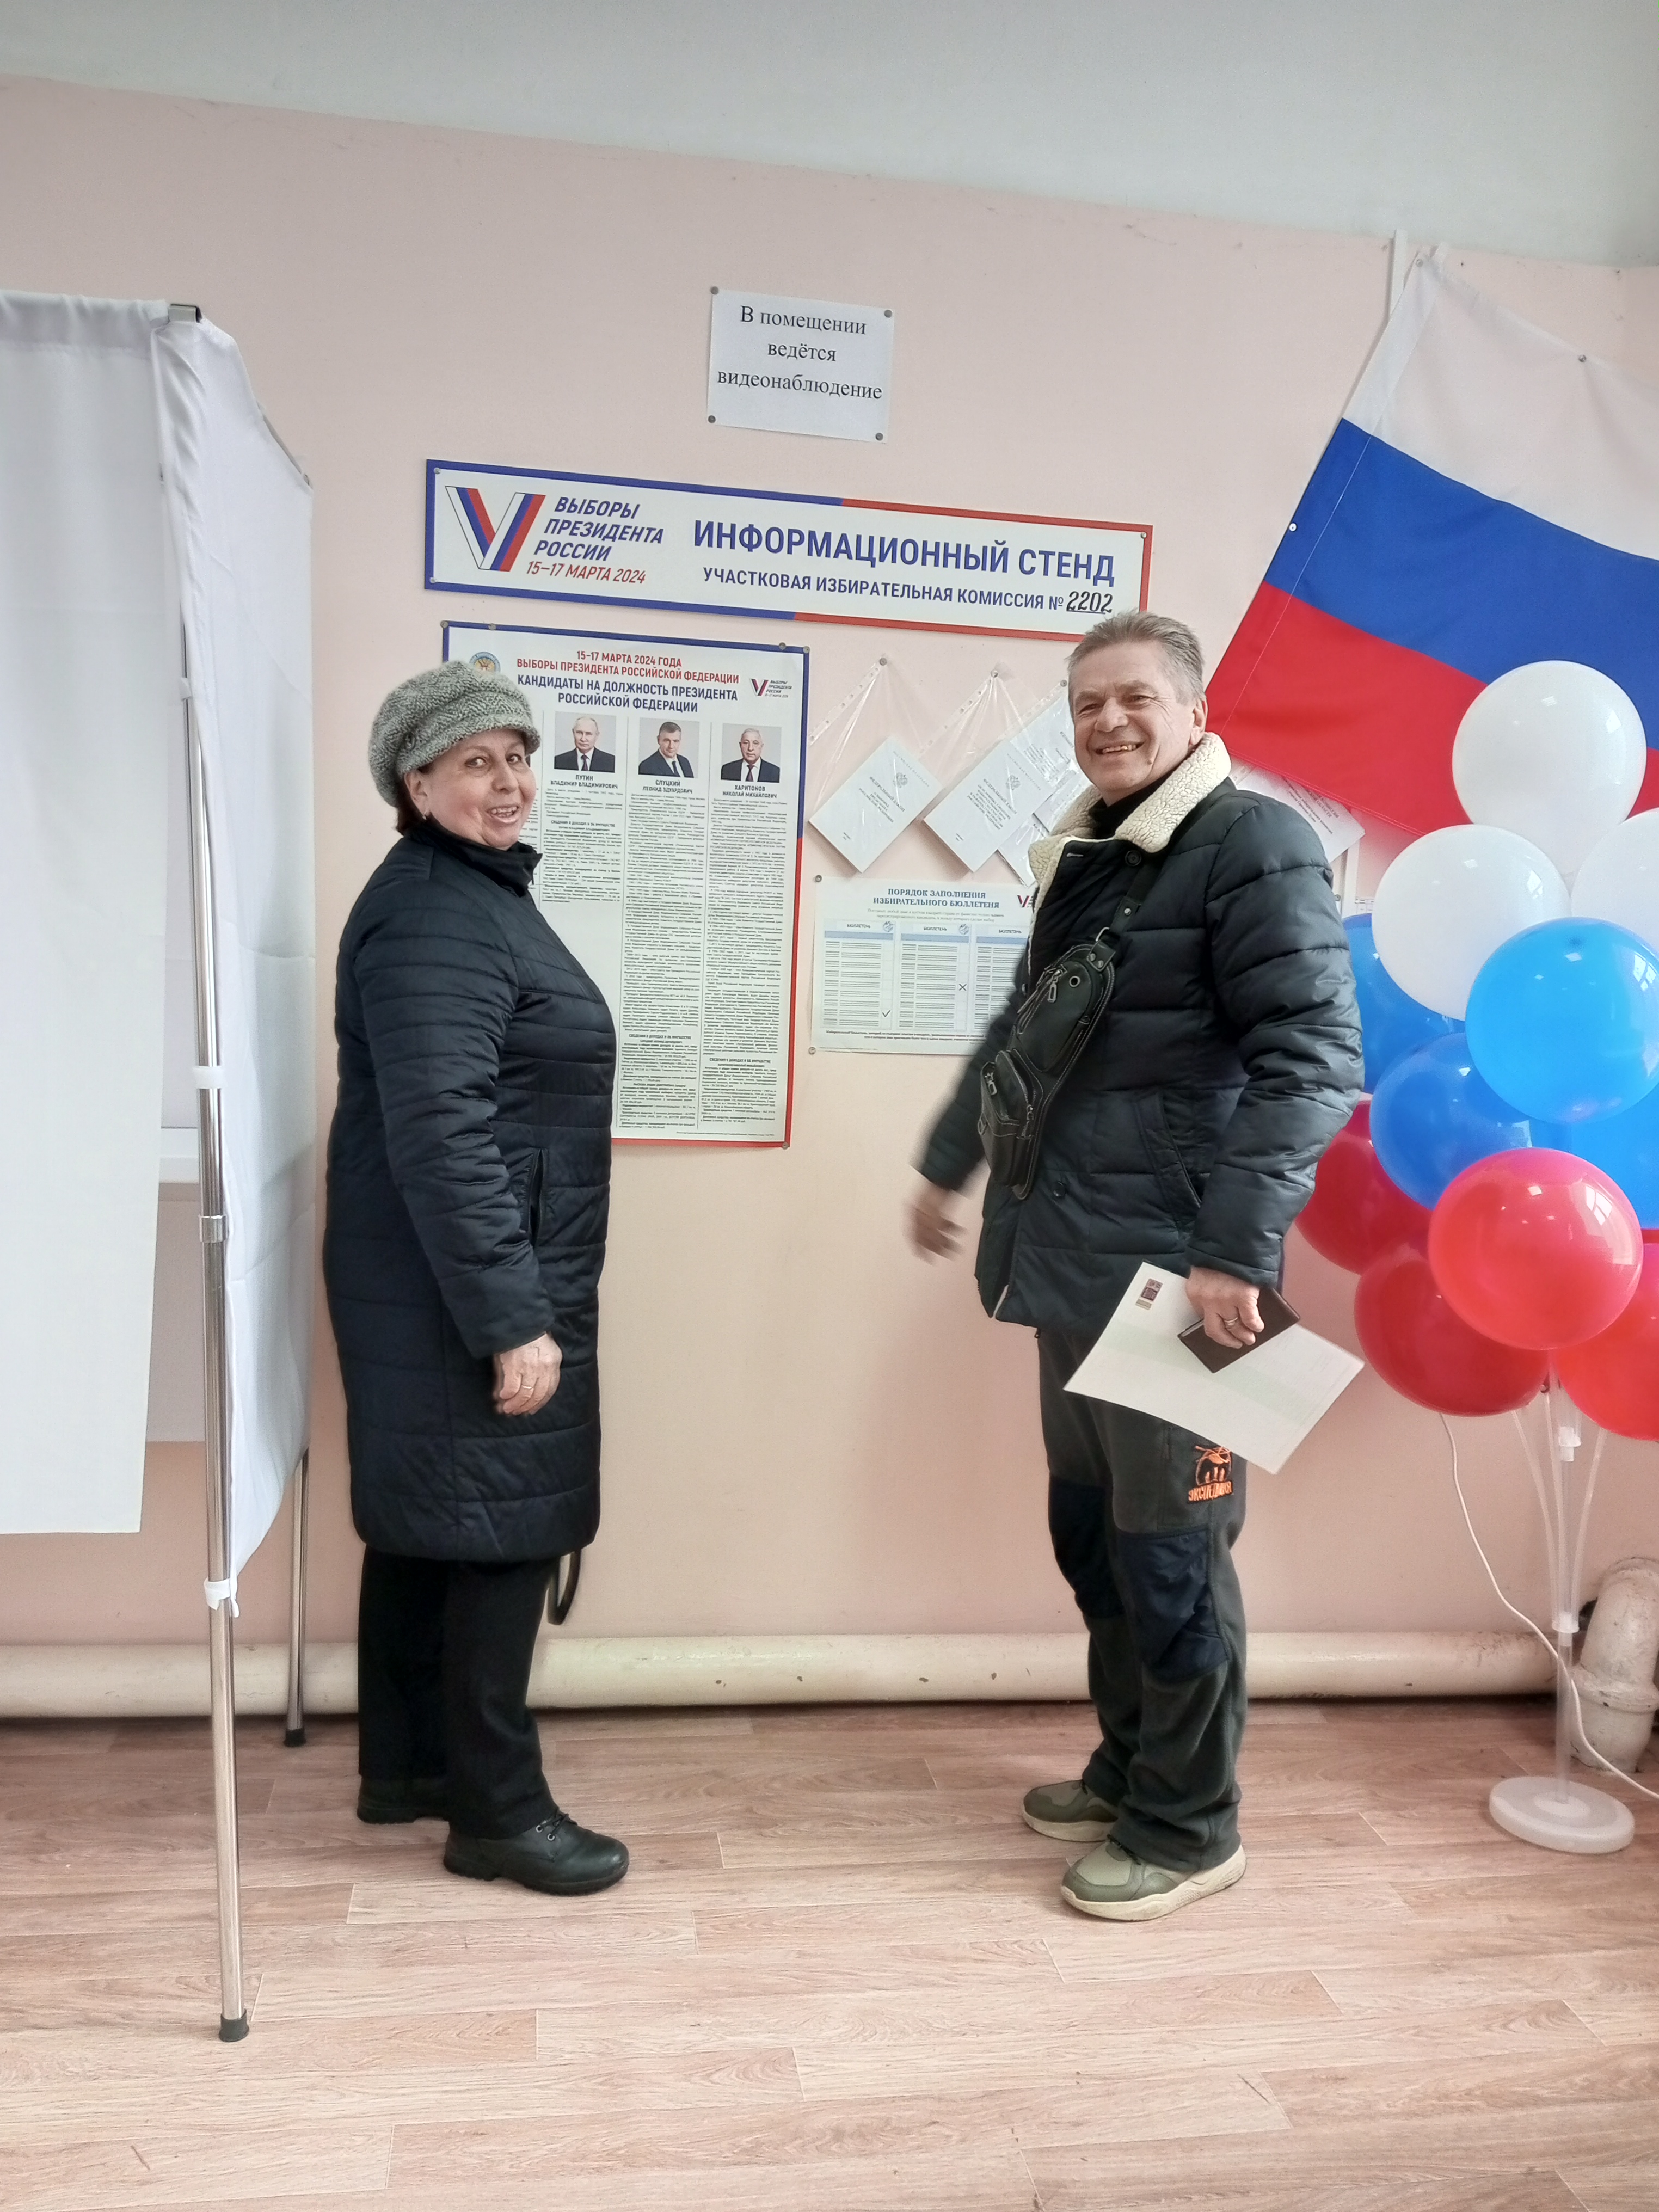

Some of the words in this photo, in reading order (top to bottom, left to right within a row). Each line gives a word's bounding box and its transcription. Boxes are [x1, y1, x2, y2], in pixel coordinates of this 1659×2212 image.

[740, 305, 754, 323] В
[760, 311, 867, 335] помещении
[767, 343, 837, 362] ведётся
[717, 371, 883, 400] видеонаблюдение
[554, 496, 641, 519] ВЫБОРЫ
[544, 518, 664, 544] ПРЕЗИДЕНТА
[533, 540, 612, 561] РОССИИ
[694, 519, 1010, 573] ИНФОРМАЦИОННЫЙ
[1018, 548, 1115, 587] СТЕНД
[565, 564, 611, 581] МАРТА
[613, 568, 647, 584] 2024
[703, 567, 811, 591] УЧАСТКОВАЯ
[816, 577, 953, 602] ИЗБИРАТЕЛЬНАЯ
[958, 589, 1044, 610] КОМИССИЯ
[1066, 591, 1113, 613] 2202
[517, 658, 558, 671] ВЫБОРЫ
[561, 662, 619, 675] ПРЕЗИДЕНТА
[622, 666, 682, 680] РОССИЙСКОЙ
[684, 671, 740, 684] ФЕДЕРАЦИИ
[602, 653, 632, 663] МАРТА
[634, 655, 656, 666] 2024
[658, 656, 682, 667] ГОДА
[518, 674, 584, 690] КАНДИДАТЫ
[587, 680, 600, 691] НА
[603, 681, 669, 696] ДОЛЖНОСТЬ
[672, 686, 738, 701] ПРЕЗИДЕНТА
[558, 693, 630, 708] РОССИЙСКОЙ
[632, 698, 698, 712] ФЕДЕРАЦИИ
[579, 781, 618, 789] ВЛАДИМИРОВИЧ
[873, 897, 948, 907] ИЗБИРАТЕЛЬНОГО
[949, 900, 1000, 909] БЮЛЛЕТЕНЯ
[888, 888, 928, 897] ПОРЯДОК
[930, 890, 986, 899] ЗАПОЛНЕНИЯ
